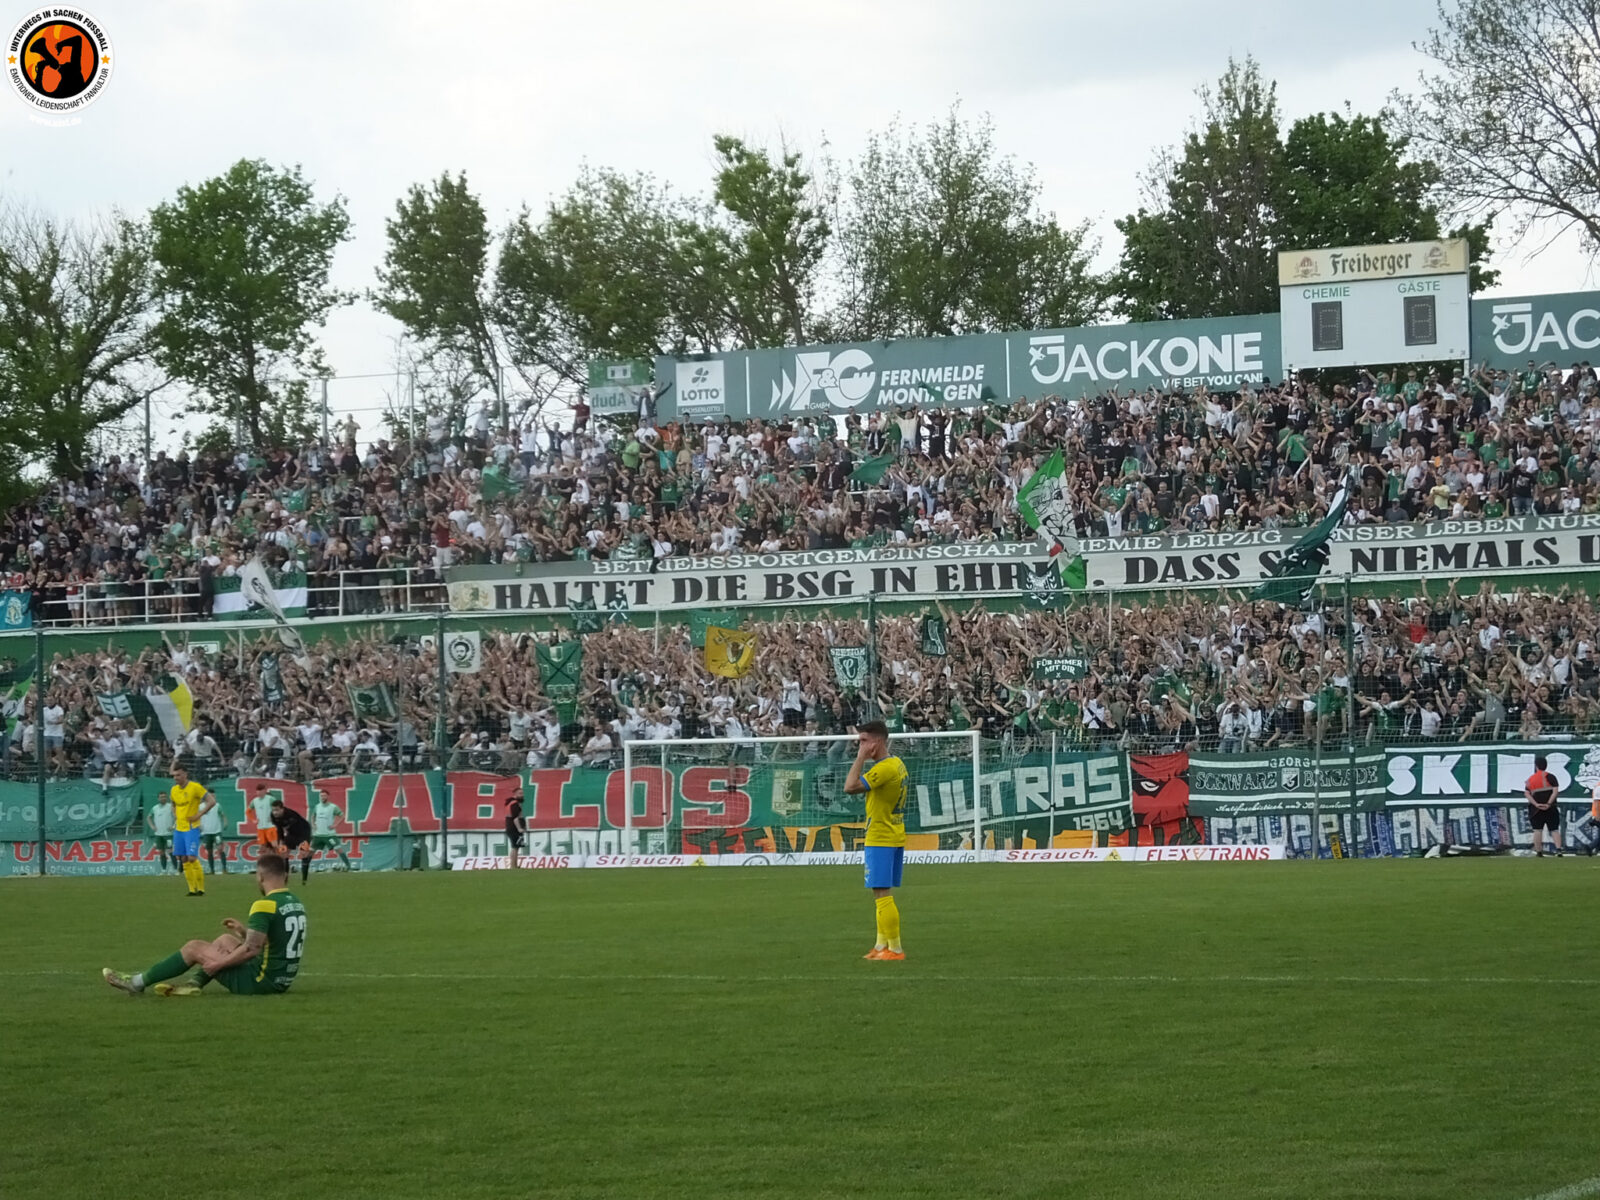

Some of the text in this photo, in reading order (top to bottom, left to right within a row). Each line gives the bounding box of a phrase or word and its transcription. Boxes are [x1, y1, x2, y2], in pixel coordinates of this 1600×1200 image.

[1329, 251, 1412, 276] Freiberger
[1303, 286, 1351, 299] CHEMIE
[1397, 280, 1441, 294] GÄSTE
[1029, 332, 1263, 384] JACKONE
[880, 364, 985, 387] FERNMELDE
[1162, 373, 1263, 389] WE BET YOU CAN!
[681, 388, 720, 401] LOTTO
[1171, 529, 1281, 549] LEIPZIG
[1331, 524, 1417, 545] NSER
[1425, 517, 1526, 537] LEBEN
[1536, 513, 1600, 531] NUR
[672, 574, 747, 604] DIE
[765, 568, 855, 600] BSG
[868, 566, 917, 593] IN
[1124, 551, 1240, 585] DASS
[1349, 536, 1560, 573] NIEMALS
[1036, 658, 1083, 669] FÜR IMMER
[1044, 664, 1076, 675] MIT DIR
[1269, 757, 1311, 768] GEORG
[1195, 766, 1379, 791] SCHWARZ BRIGADE
[1387, 752, 1572, 796] SKINS
[236, 765, 752, 837] DIABLOS
[916, 756, 1122, 827] ULTRAS
[1073, 810, 1123, 831] 1964
[1392, 807, 1490, 850] ANTI
[1510, 807, 1593, 848] LK
[518, 854, 570, 869] TRANS
[1006, 848, 1098, 861] Strauch.
[1146, 847, 1271, 861] FLEX TRANS
